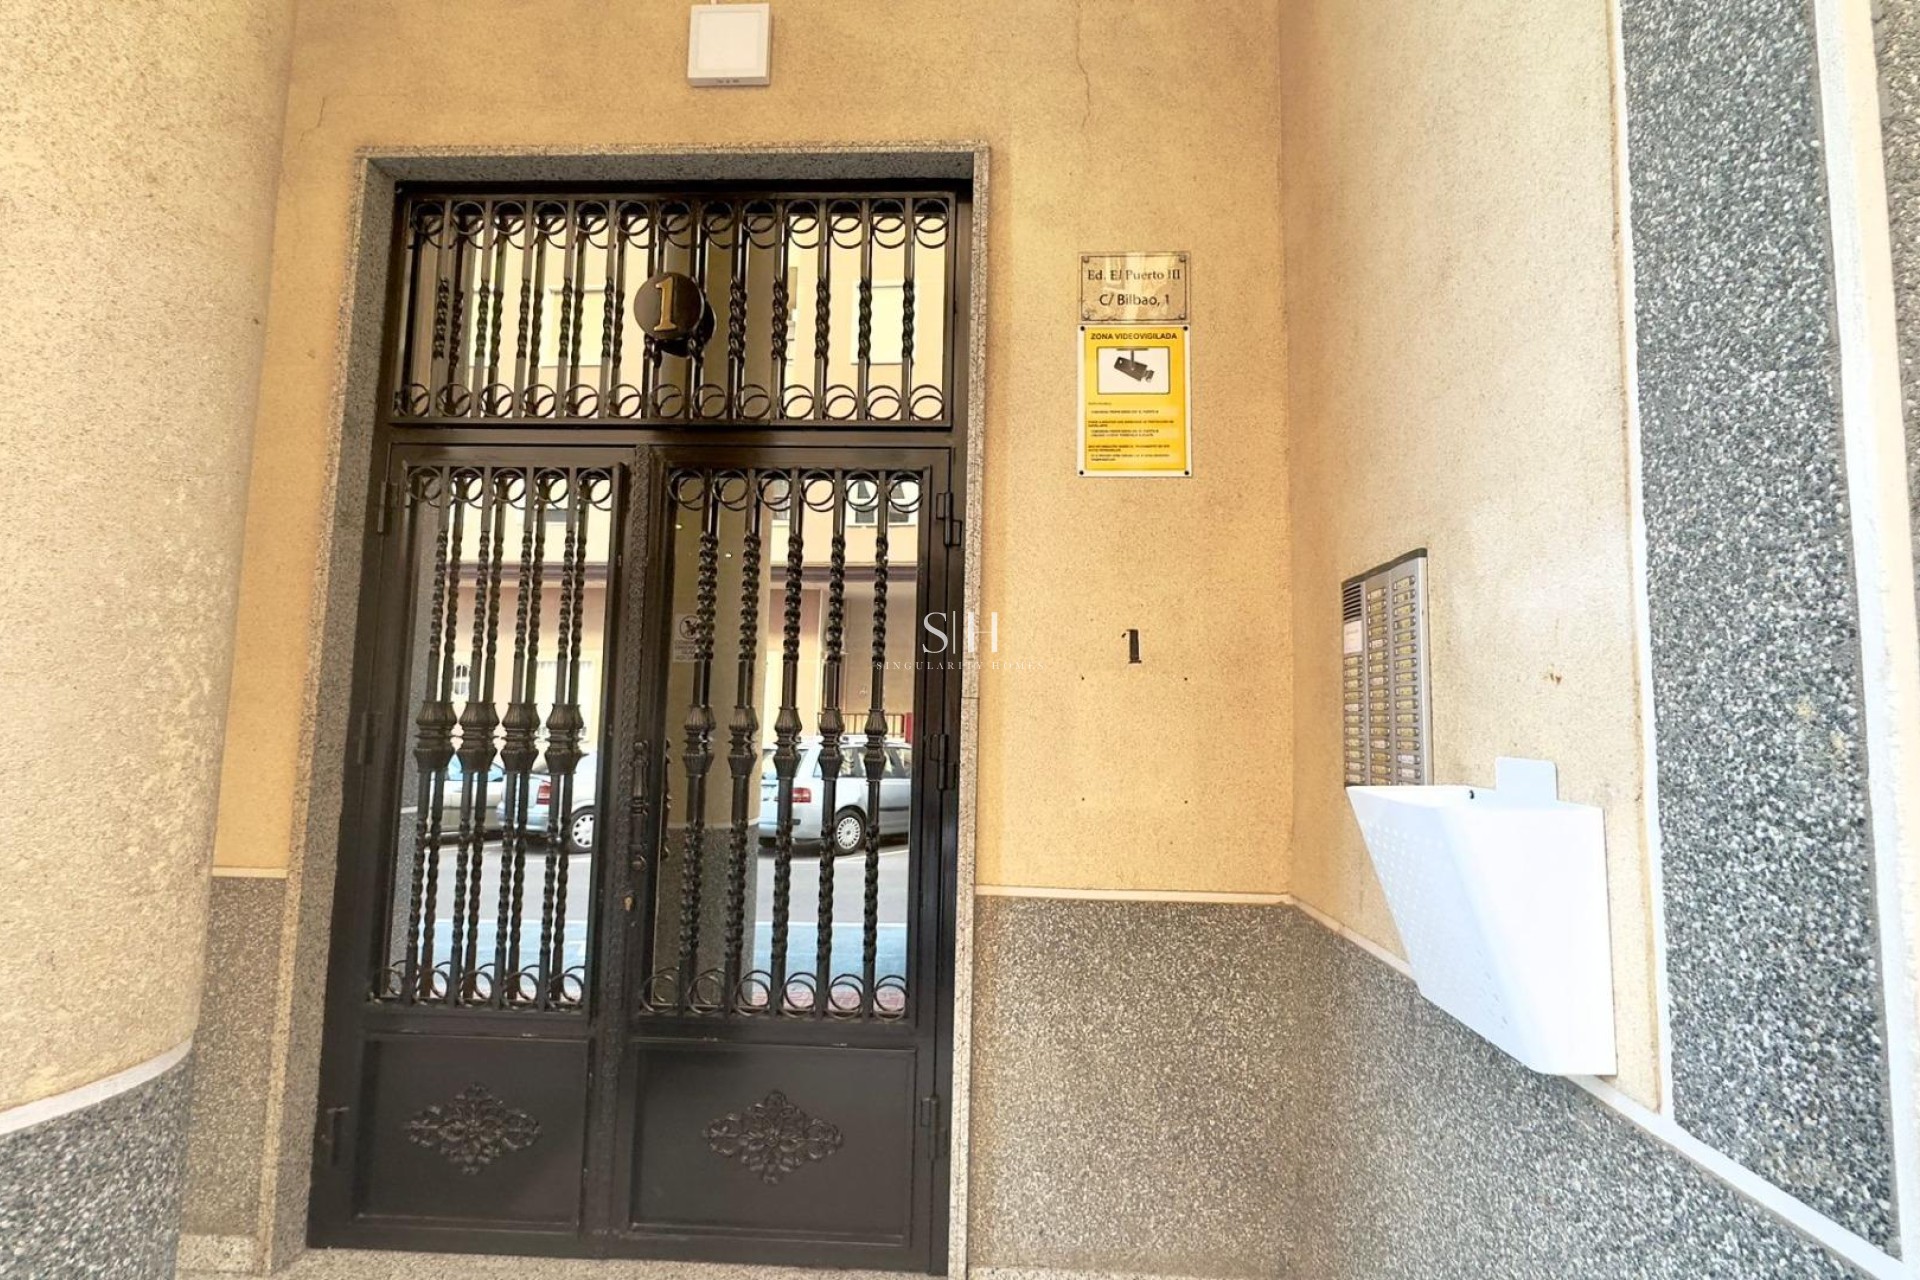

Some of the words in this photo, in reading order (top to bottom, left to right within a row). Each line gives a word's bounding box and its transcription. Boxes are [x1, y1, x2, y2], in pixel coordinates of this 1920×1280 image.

[1087, 269, 1106, 281] Ed.
[1125, 269, 1165, 281] Puerto
[1167, 268, 1181, 280] III
[653, 276, 677, 332] 1
[1099, 292, 1115, 306] C/
[1117, 293, 1161, 307] Bilbao,
[1164, 294, 1170, 305] 1
[1090, 332, 1114, 340] ZONA
[1114, 332, 1178, 340] VIDEOVIGILADA
